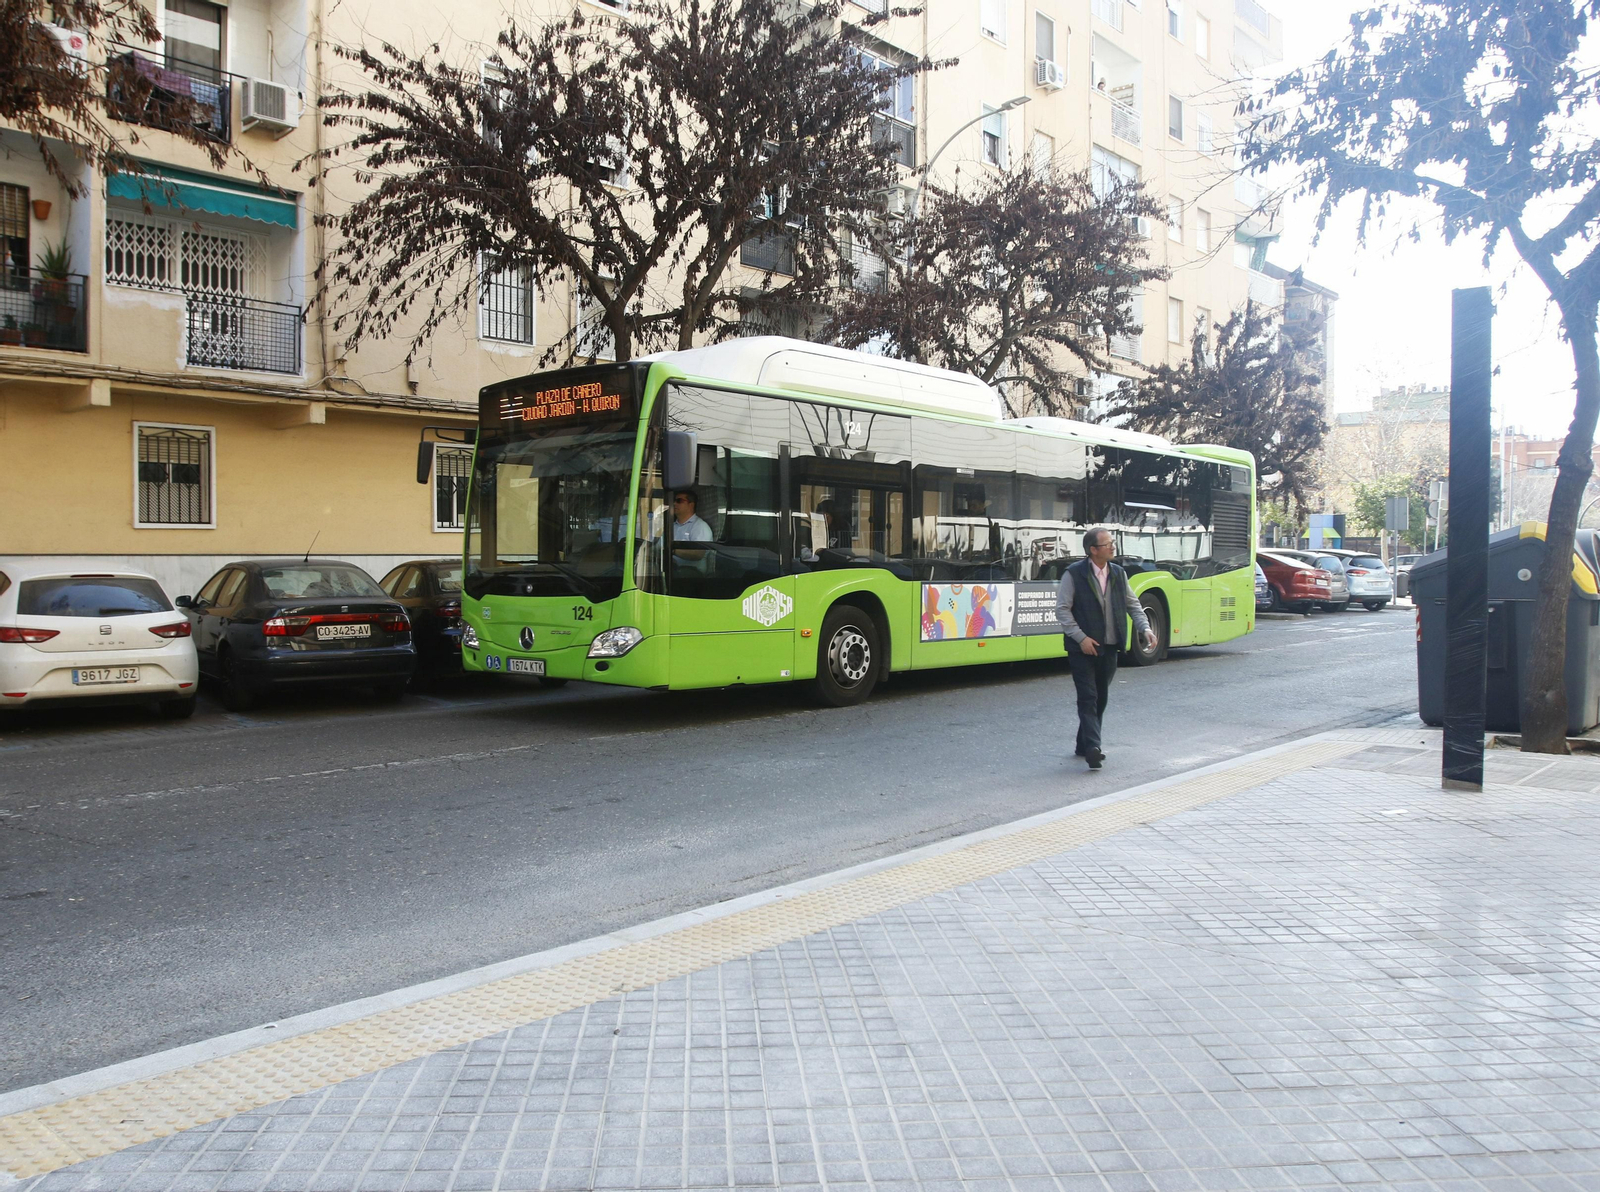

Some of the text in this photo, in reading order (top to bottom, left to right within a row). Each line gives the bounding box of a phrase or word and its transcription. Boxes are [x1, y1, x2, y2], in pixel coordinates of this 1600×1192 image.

[536, 389, 560, 405] PLAZA
[561, 387, 571, 402] DE
[522, 405, 548, 421] CIUDAD
[549, 401, 575, 417] JARDIN
[583, 399, 590, 413] H.
[591, 394, 620, 412] QUIRON
[845, 421, 861, 436] 124
[1018, 591, 1057, 599] COMPRANDO EN EL
[1018, 599, 1037, 608] PEQUEÑO
[572, 606, 593, 621] 124
[1017, 612, 1043, 624] GRANDE
[512, 660, 543, 673] 1674 KTK
[81, 668, 136, 681] 9617 JGZ
